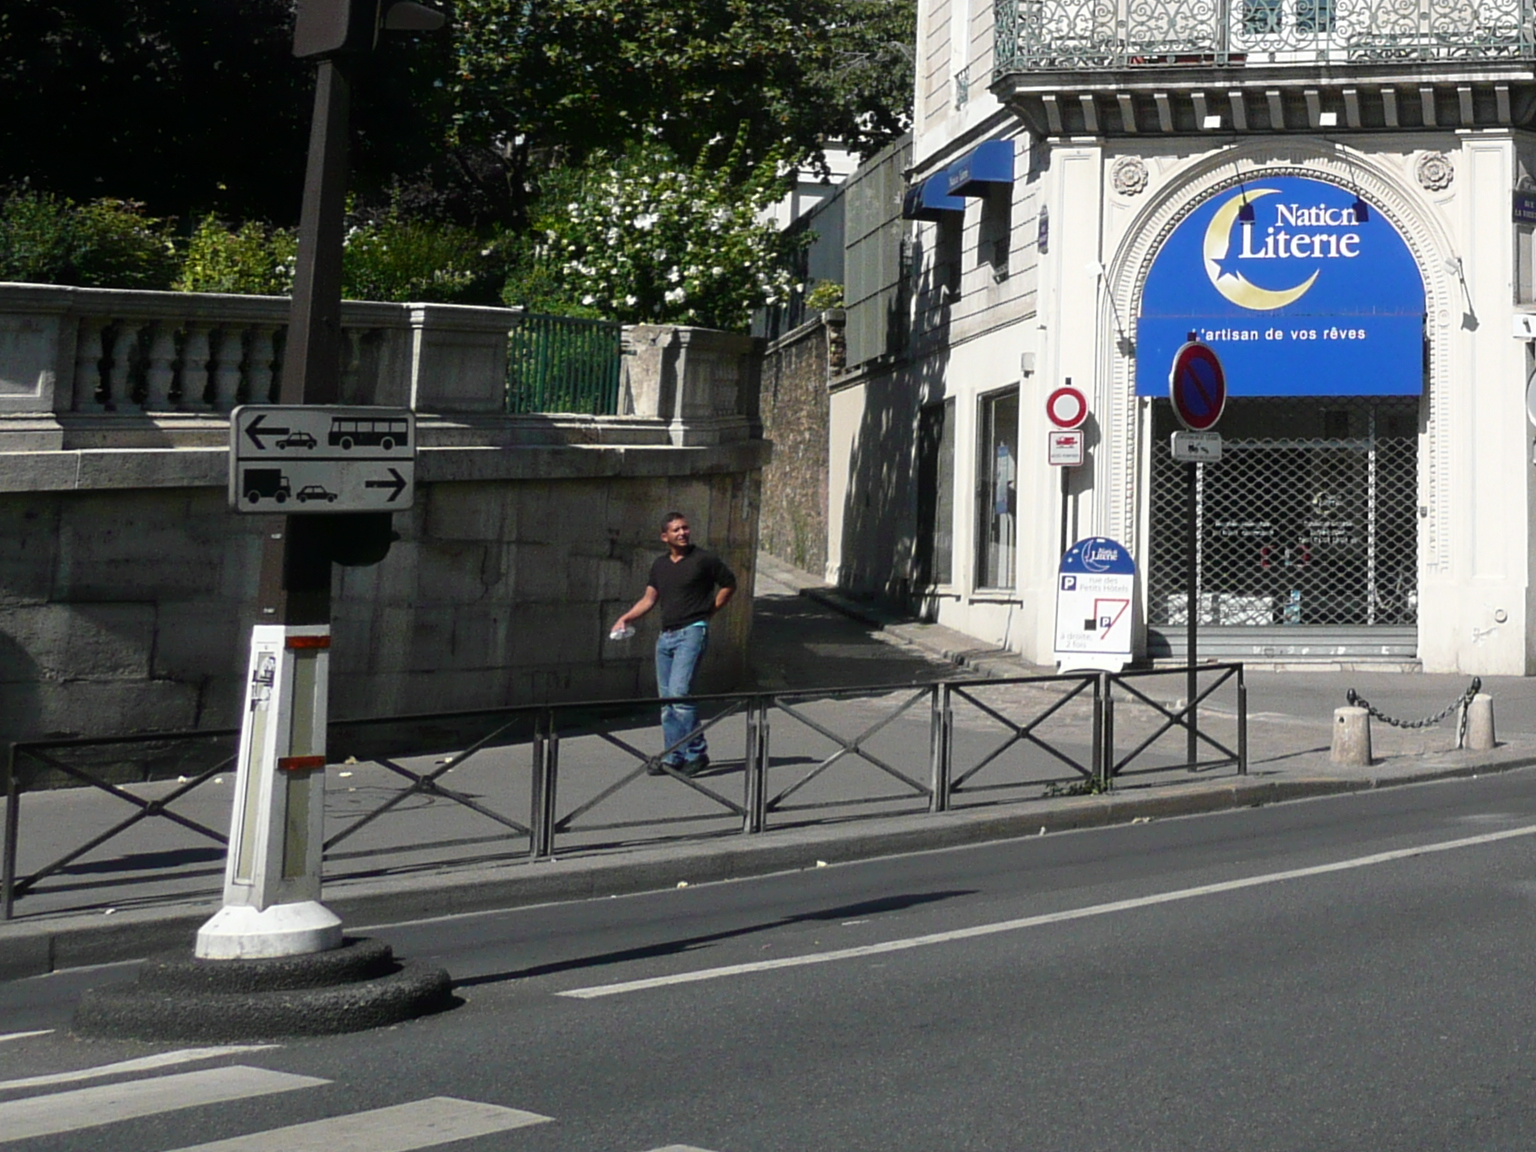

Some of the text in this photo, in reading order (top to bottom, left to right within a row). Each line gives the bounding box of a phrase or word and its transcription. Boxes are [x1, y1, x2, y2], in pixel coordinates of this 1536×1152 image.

[1274, 203, 1359, 227] Nation
[1237, 223, 1361, 259] Literie
[1192, 326, 1366, 341] 'artisan de vos rêves
[1064, 577, 1075, 590] P
[1104, 576, 1118, 584] des
[1079, 584, 1101, 593] Petits
[1065, 639, 1087, 648] 2 fois
